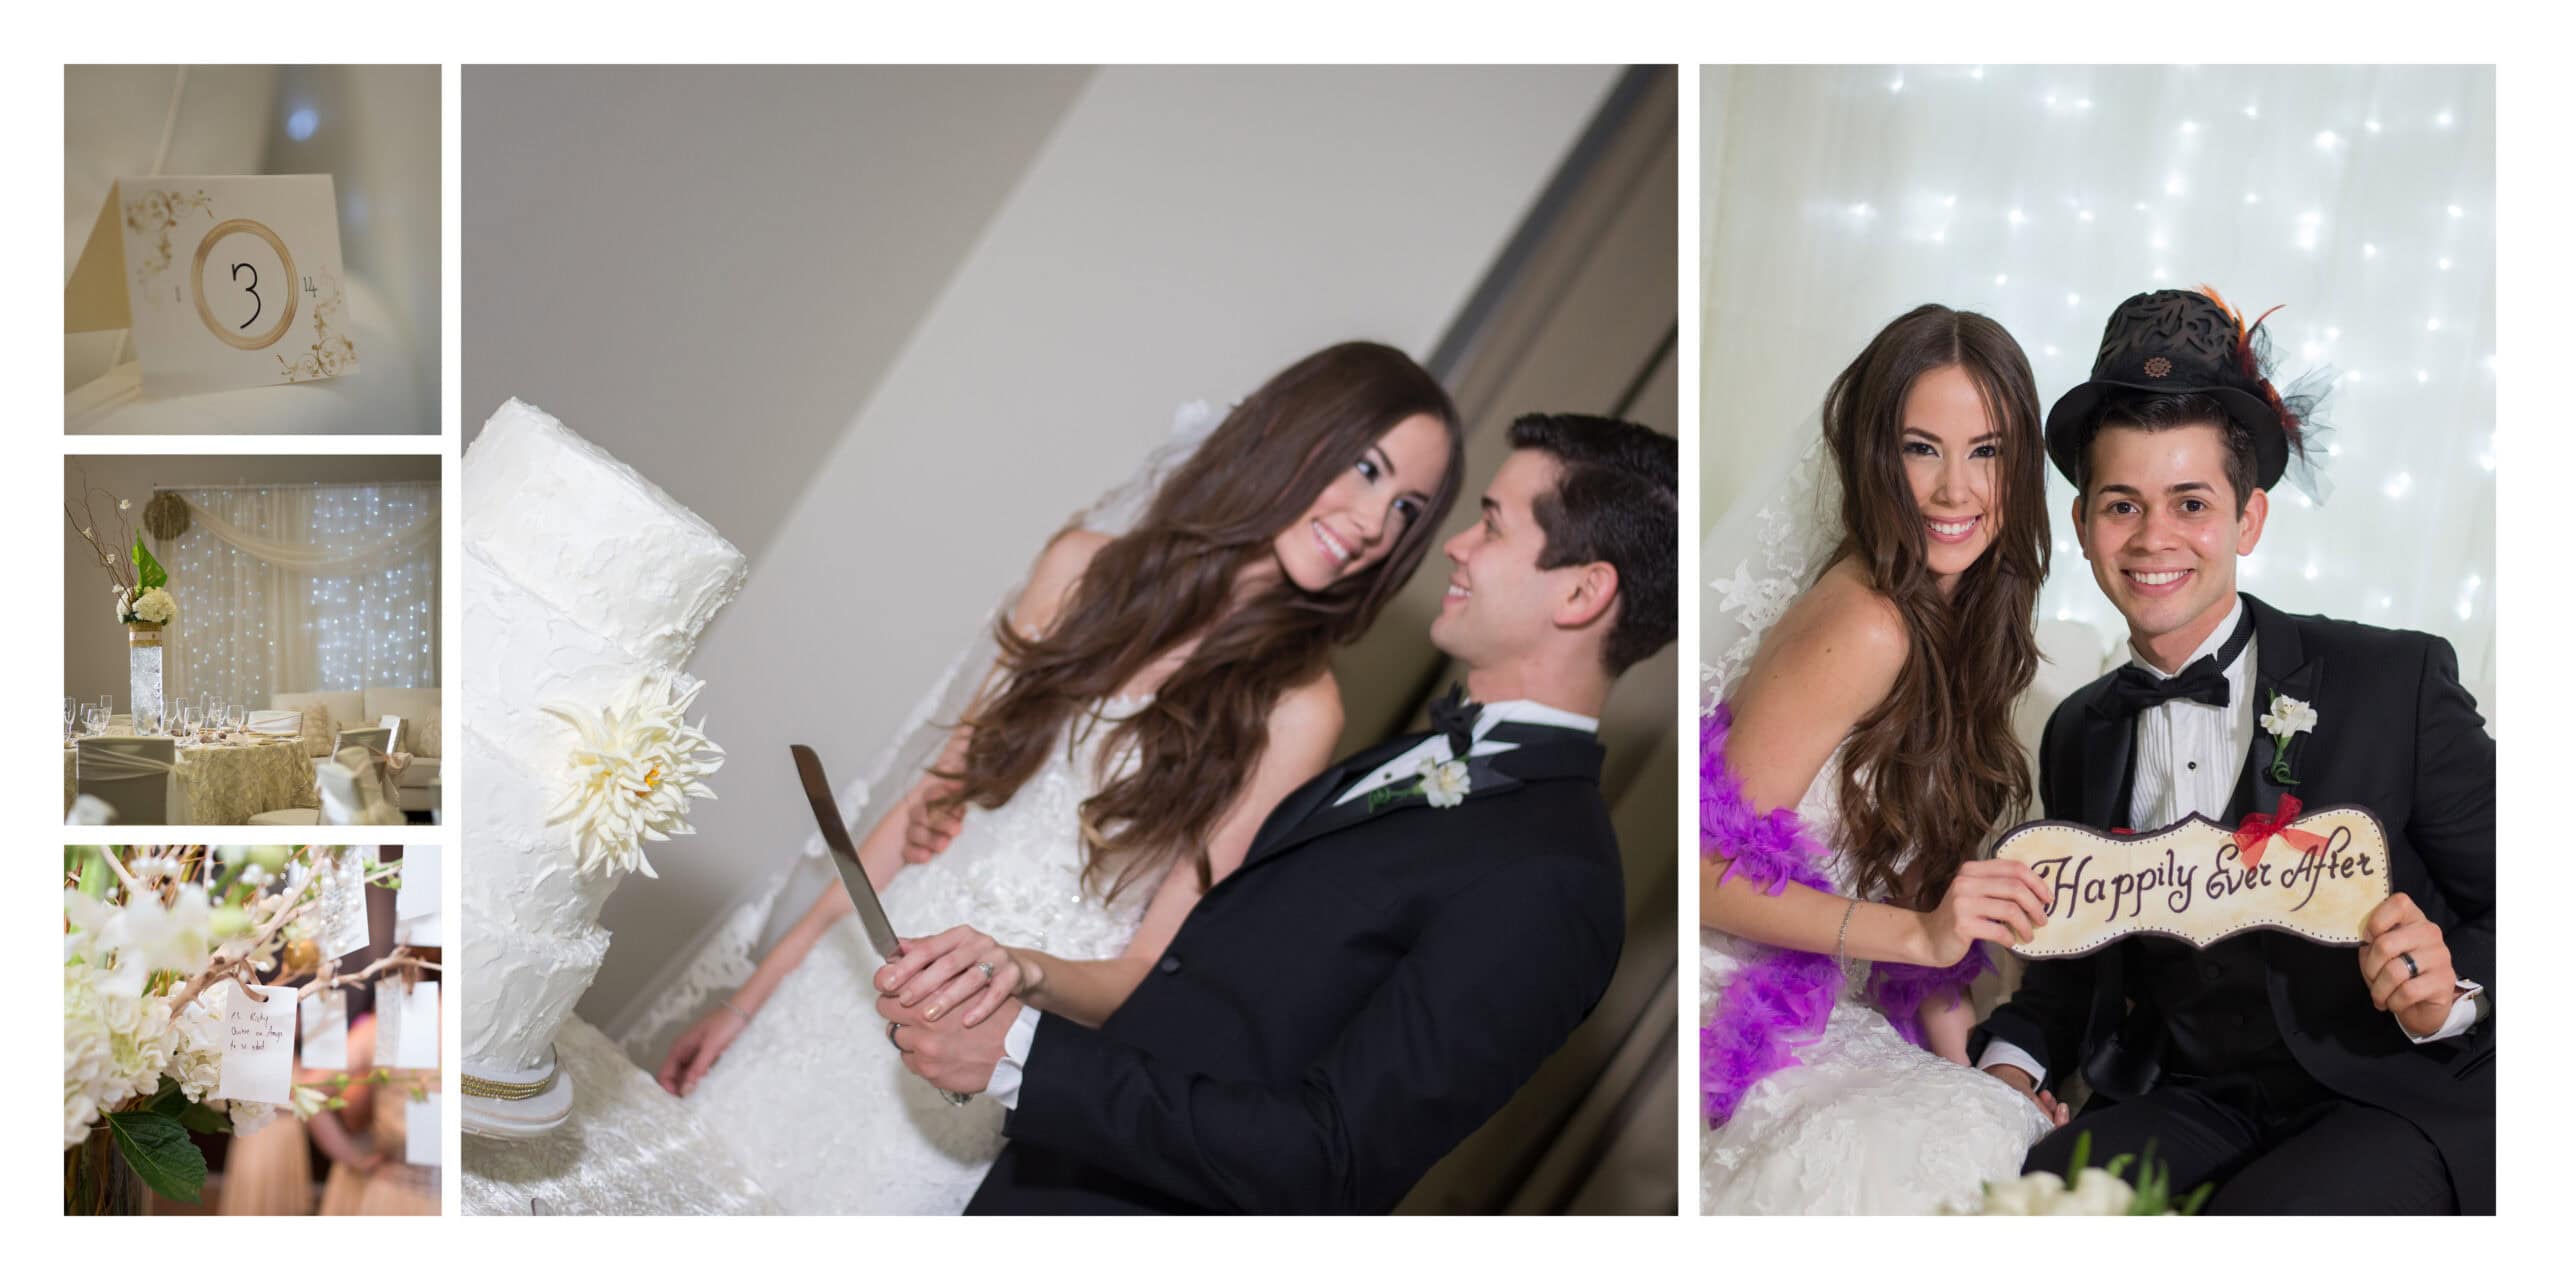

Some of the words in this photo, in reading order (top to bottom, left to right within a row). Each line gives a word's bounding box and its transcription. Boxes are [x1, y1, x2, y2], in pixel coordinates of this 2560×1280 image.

[231, 263, 261, 329] 3
[2031, 848, 2199, 923] Happily
[2205, 843, 2274, 900] Ever
[2281, 825, 2374, 912] After
